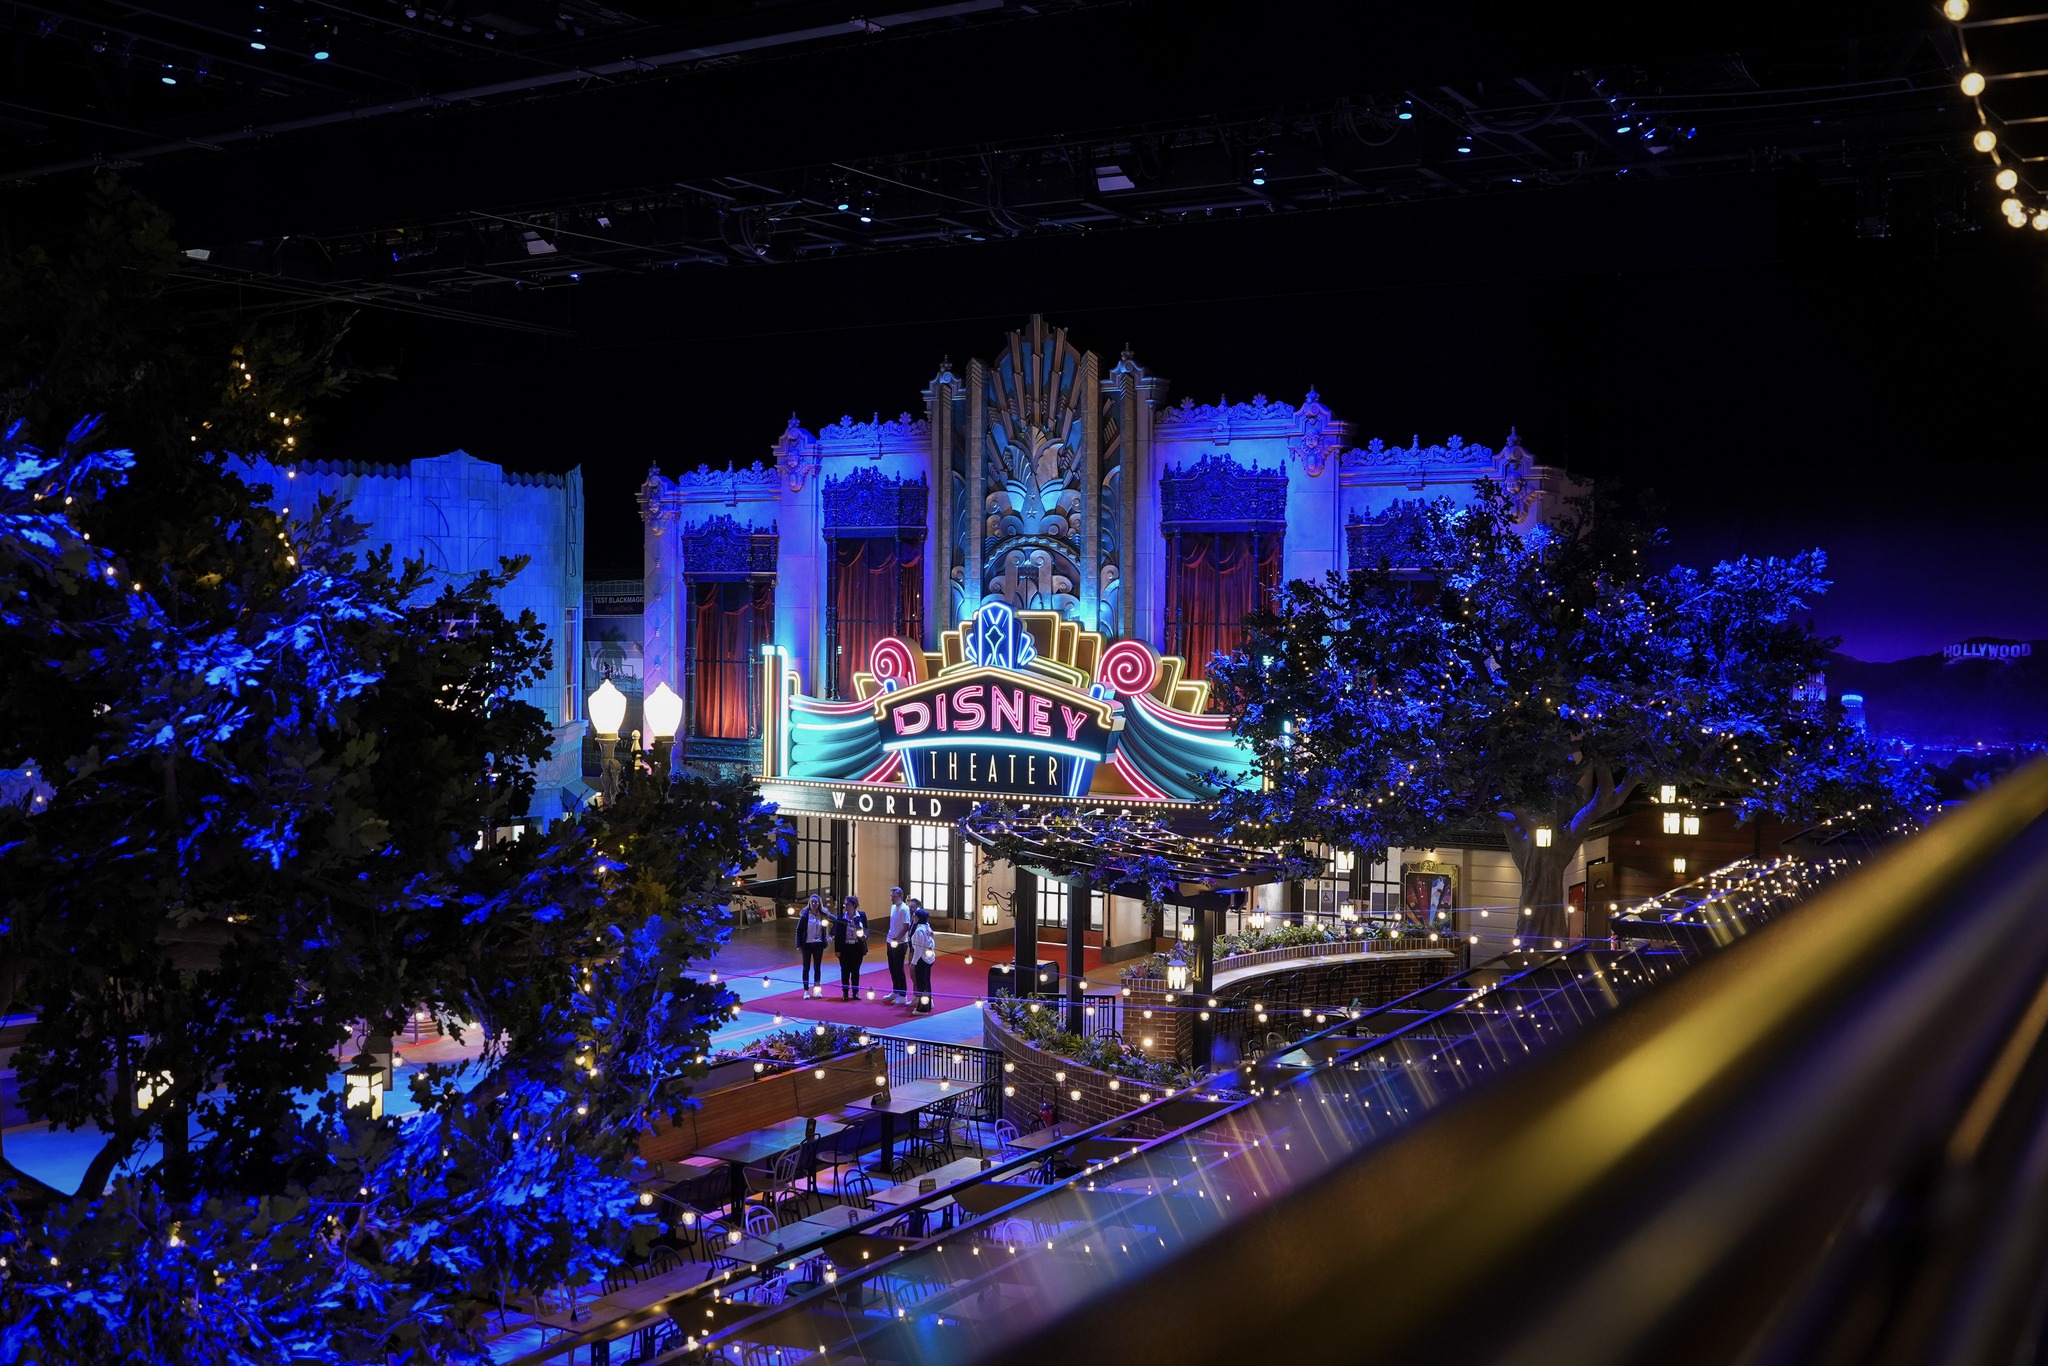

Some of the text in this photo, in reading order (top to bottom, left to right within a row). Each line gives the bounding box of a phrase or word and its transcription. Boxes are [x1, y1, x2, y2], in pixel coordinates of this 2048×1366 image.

[1943, 643, 2032, 658] HOLLYWOOD
[894, 685, 1088, 741] DISNEY
[930, 752, 1059, 786] THEATER
[832, 791, 942, 817] WORLD
